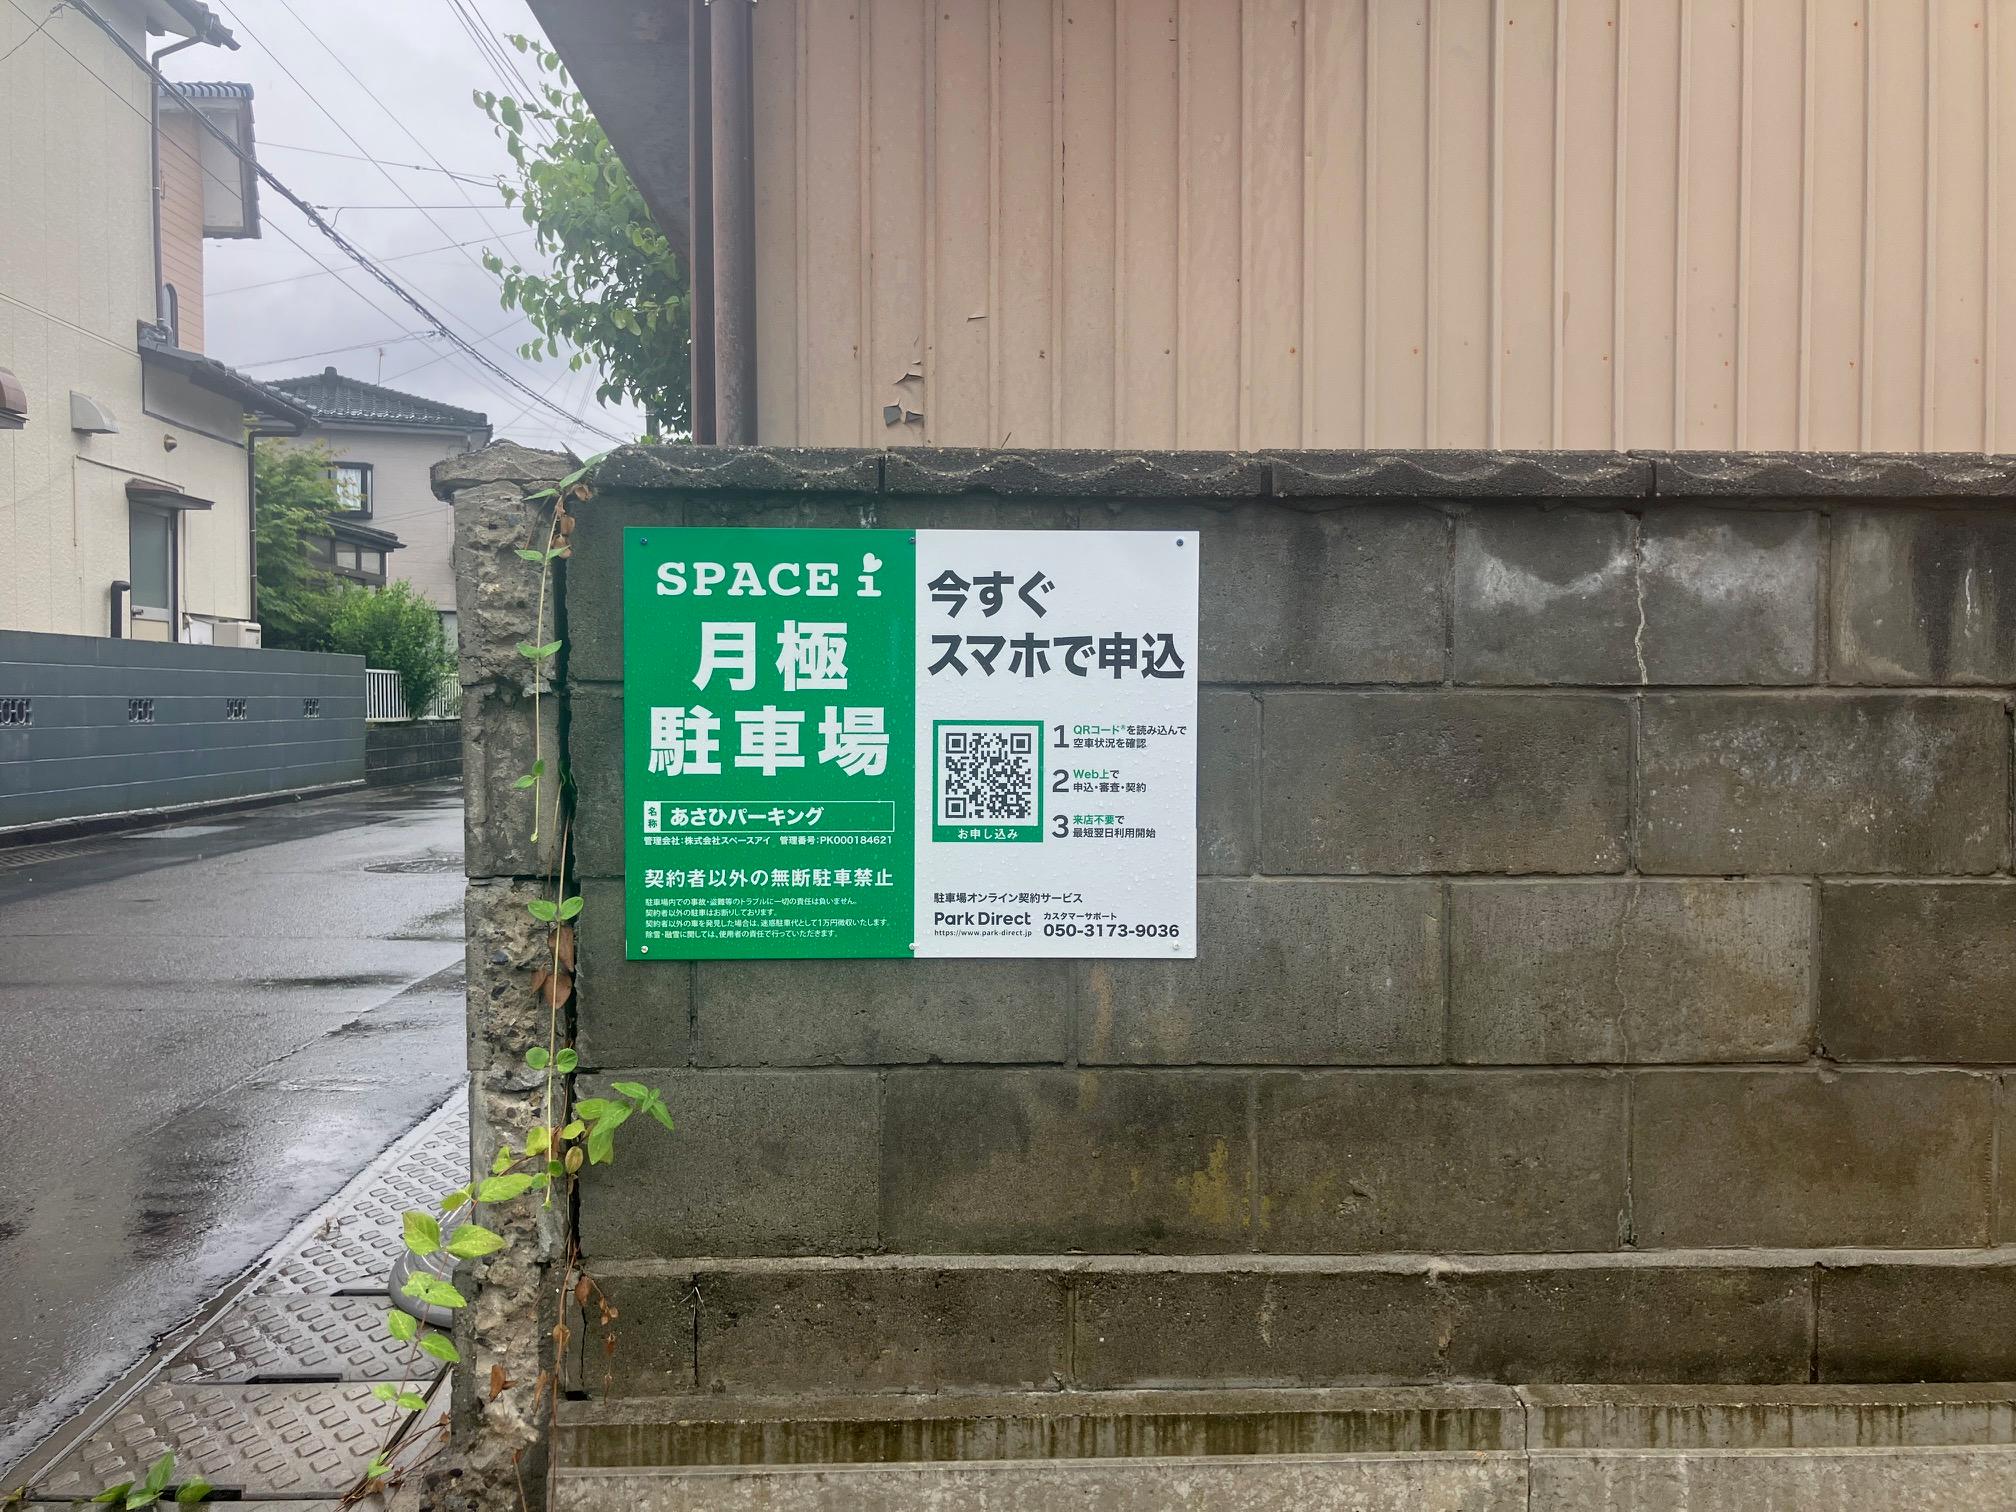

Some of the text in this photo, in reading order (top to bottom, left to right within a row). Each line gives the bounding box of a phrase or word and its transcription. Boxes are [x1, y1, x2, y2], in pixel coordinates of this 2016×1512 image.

[656, 552, 883, 597] SPACE i
[927, 569, 1056, 619] 今すぐ
[691, 619, 849, 692] 月極
[927, 631, 1186, 680] スマホで申込
[647, 704, 890, 777] 駐車場
[1053, 725, 1070, 748] 1
[1073, 738, 1147, 749] 空車状況を確認
[1052, 769, 1070, 793] 2
[1073, 769, 1120, 780] Web上で
[1073, 782, 1147, 793] 申込・審査・契約
[670, 806, 825, 827] あさひパーキング
[1072, 814, 1125, 826] 来店不要で
[957, 828, 1018, 840] お申し込み
[1052, 814, 1070, 839] 3
[1072, 827, 1156, 839] 最短翌日利用開始
[644, 868, 894, 889] 契約者以外の無断駐車禁止
[933, 892, 1083, 904] 駐車場オンライン契約サービス
[934, 912, 1032, 926] Park Direct
[1043, 912, 1118, 921] カスタマーサポート
[934, 929, 1033, 938] https://www.park-direct.jp
[1043, 923, 1180, 938] 050-3173-9036
